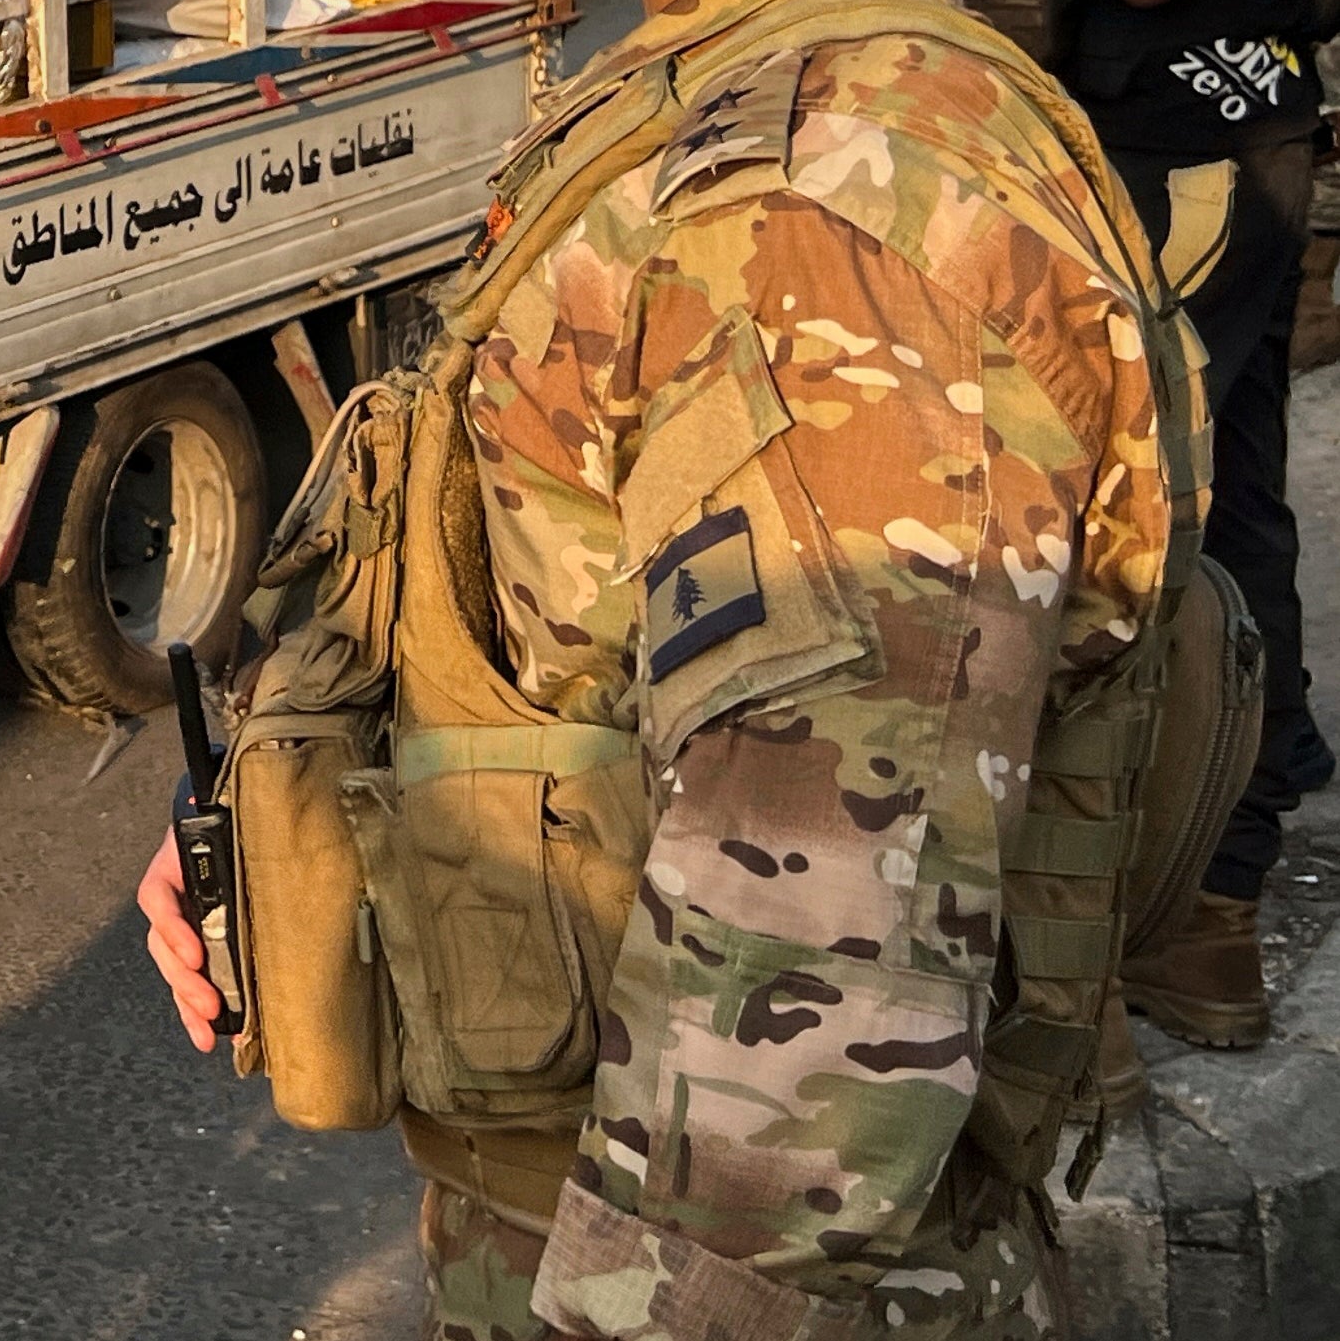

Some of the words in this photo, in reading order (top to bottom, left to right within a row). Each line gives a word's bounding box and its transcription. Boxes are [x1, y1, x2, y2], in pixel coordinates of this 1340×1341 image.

[1168, 50, 1247, 122] zero
[260, 138, 321, 195] عامة
[330, 107, 415, 180] نقليات
[2, 189, 114, 286] المناطق
[123, 182, 204, 251] جميع
